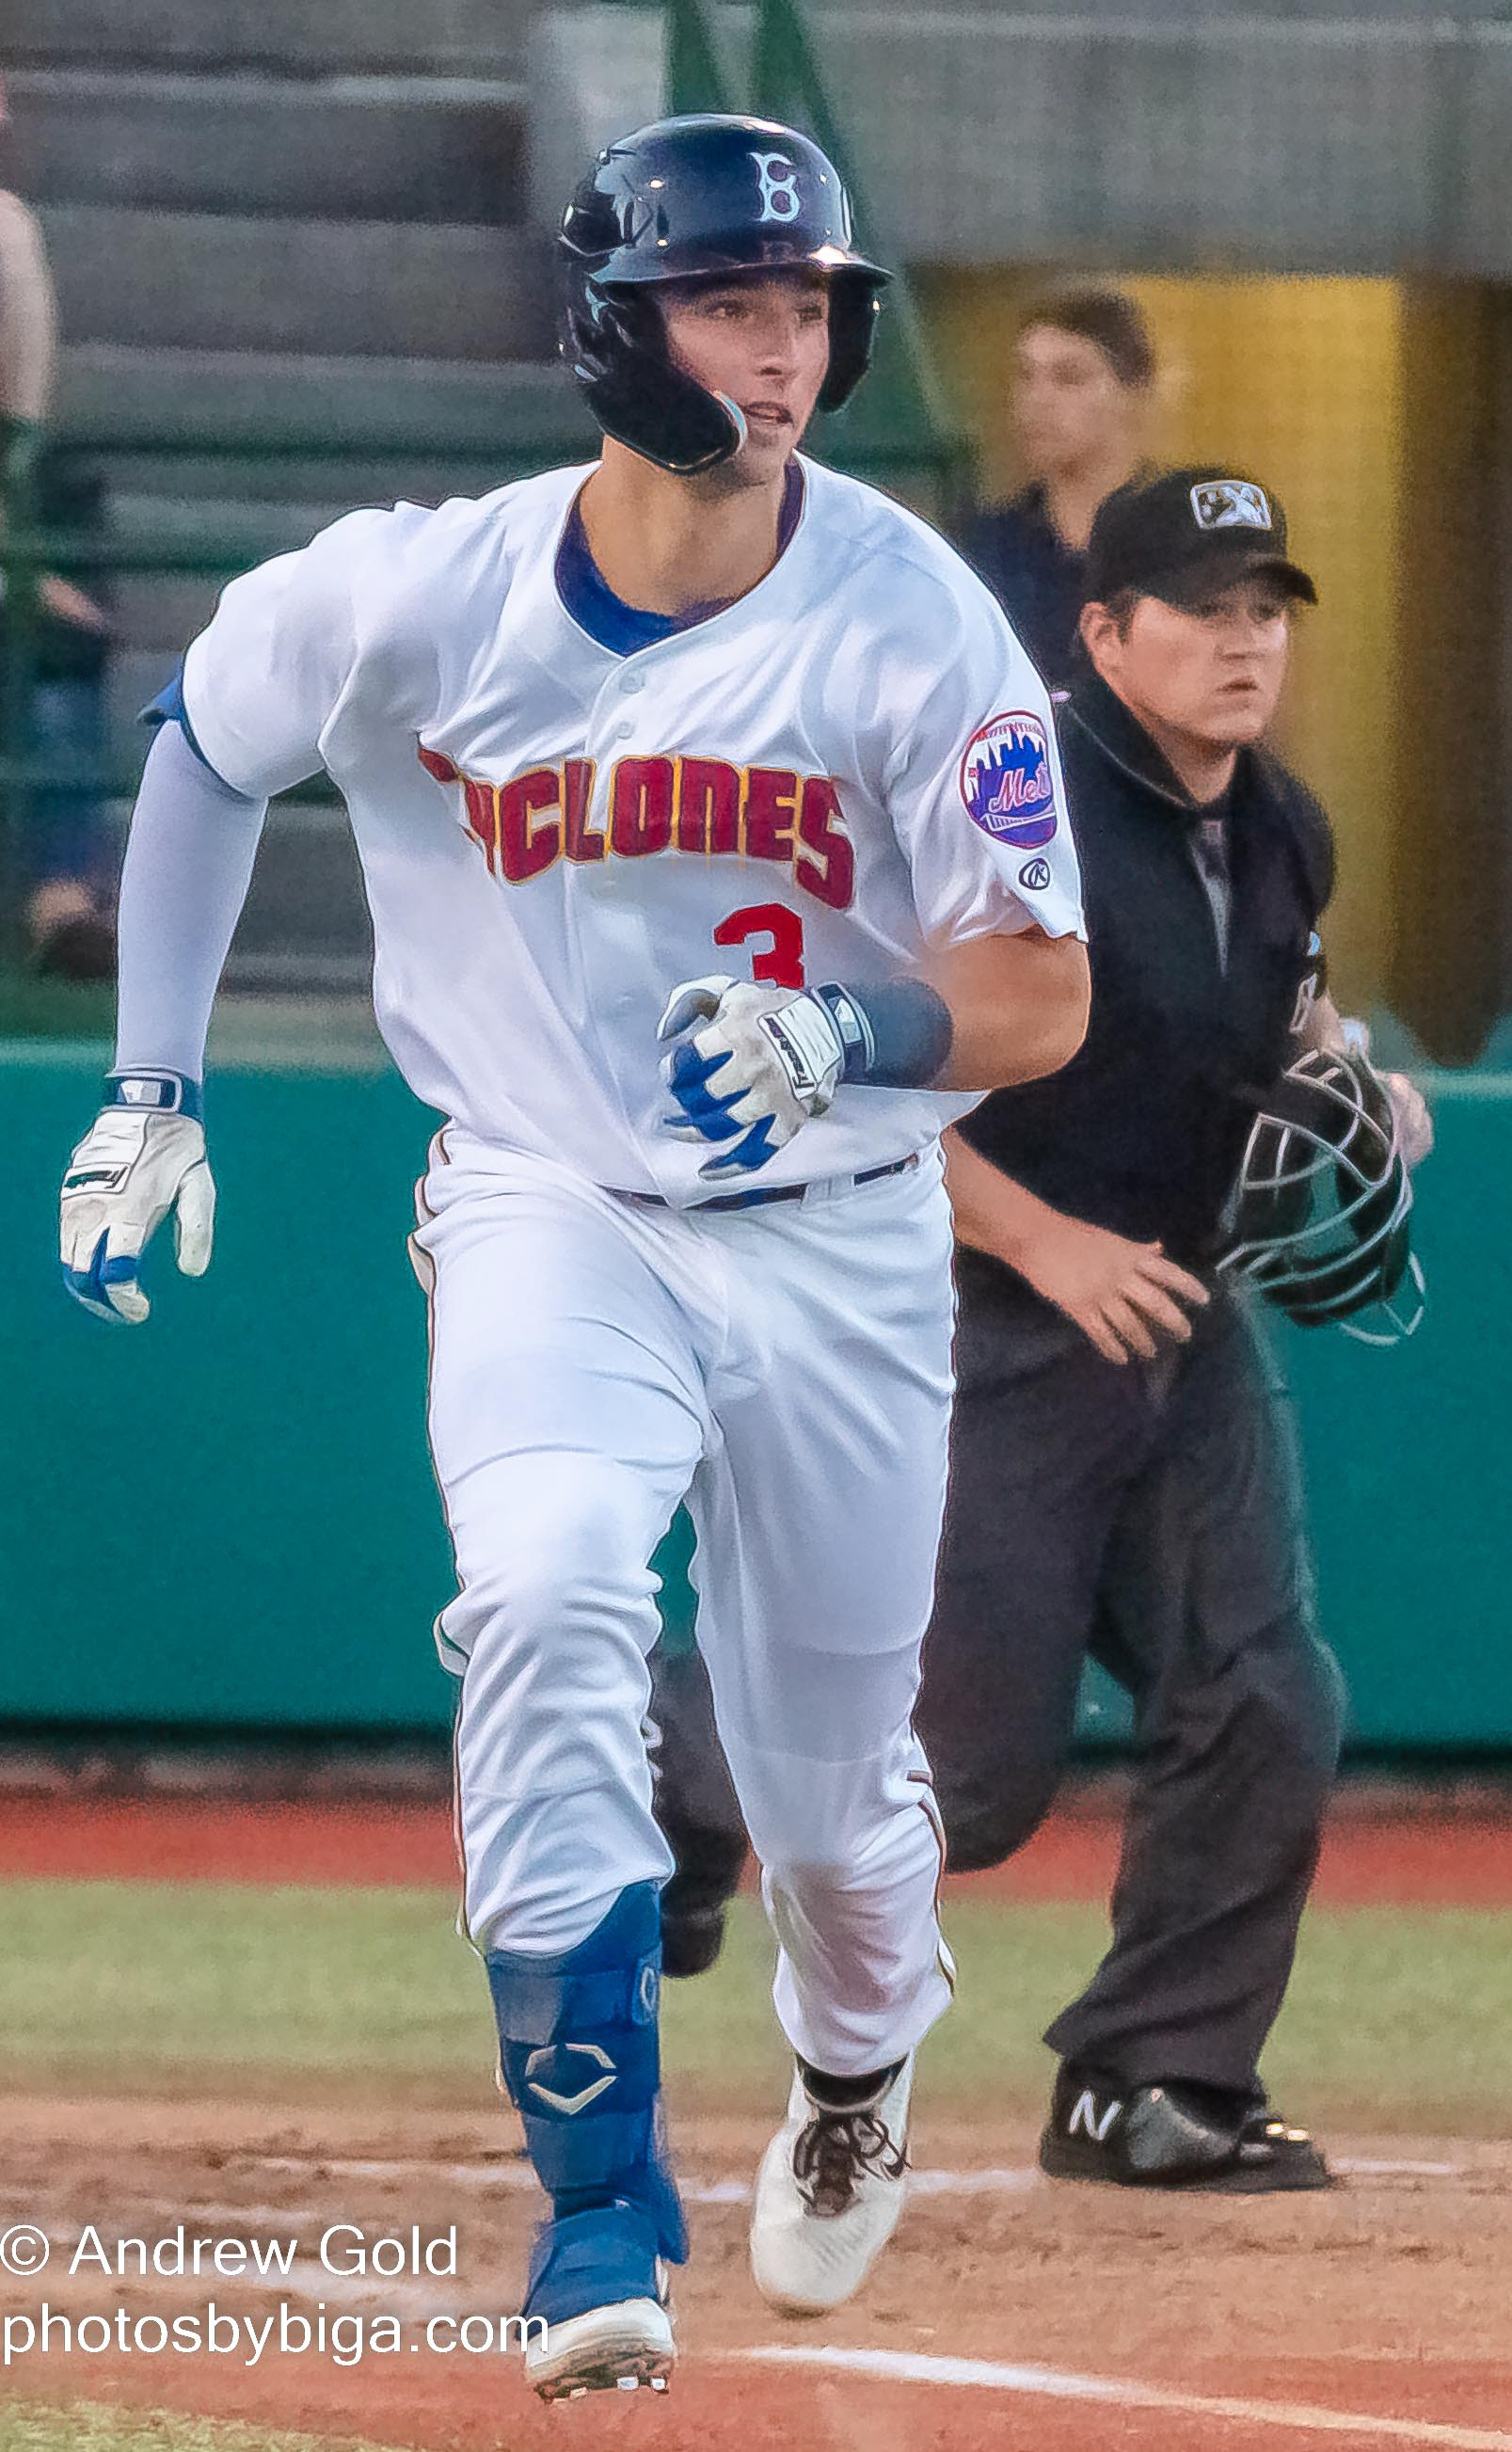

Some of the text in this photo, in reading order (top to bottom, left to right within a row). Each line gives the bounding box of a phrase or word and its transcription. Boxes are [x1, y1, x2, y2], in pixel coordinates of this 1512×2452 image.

[750, 152, 800, 223] B
[417, 745, 855, 910] CLONES
[713, 901, 805, 989] 3
